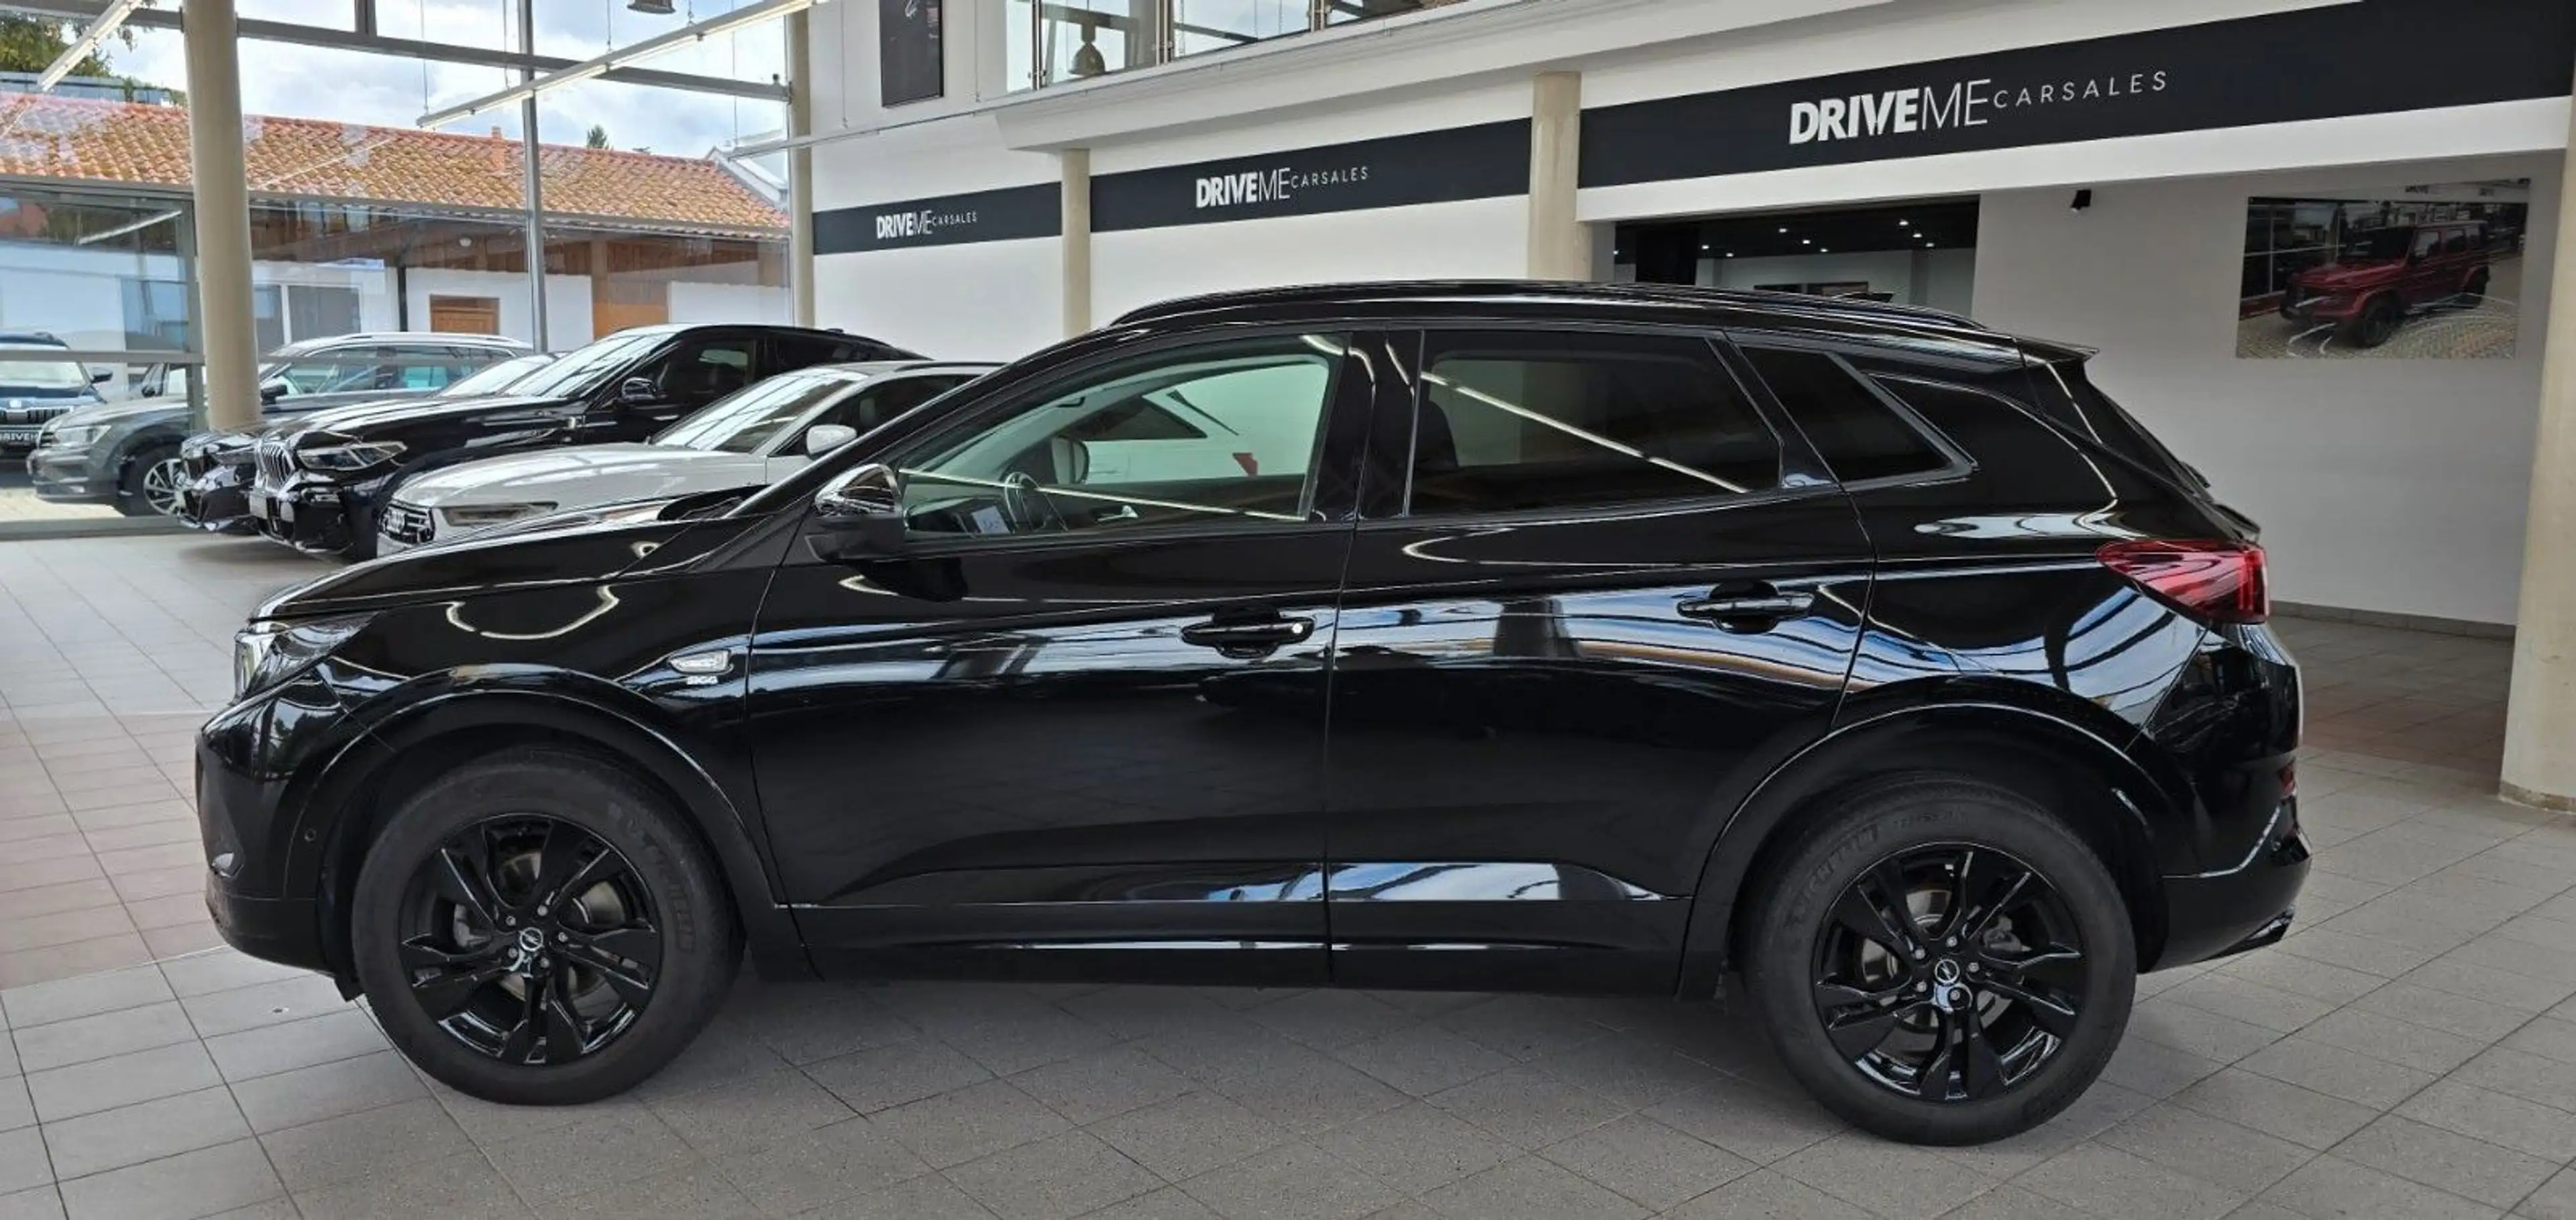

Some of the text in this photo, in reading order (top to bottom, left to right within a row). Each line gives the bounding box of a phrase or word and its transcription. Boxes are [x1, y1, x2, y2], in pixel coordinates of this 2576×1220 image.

[1789, 70, 2167, 144] DRIVEME CARSALES
[1196, 166, 1368, 208] DRIVEME CARSALES
[875, 210, 977, 239] DRIVEME CARSALES
